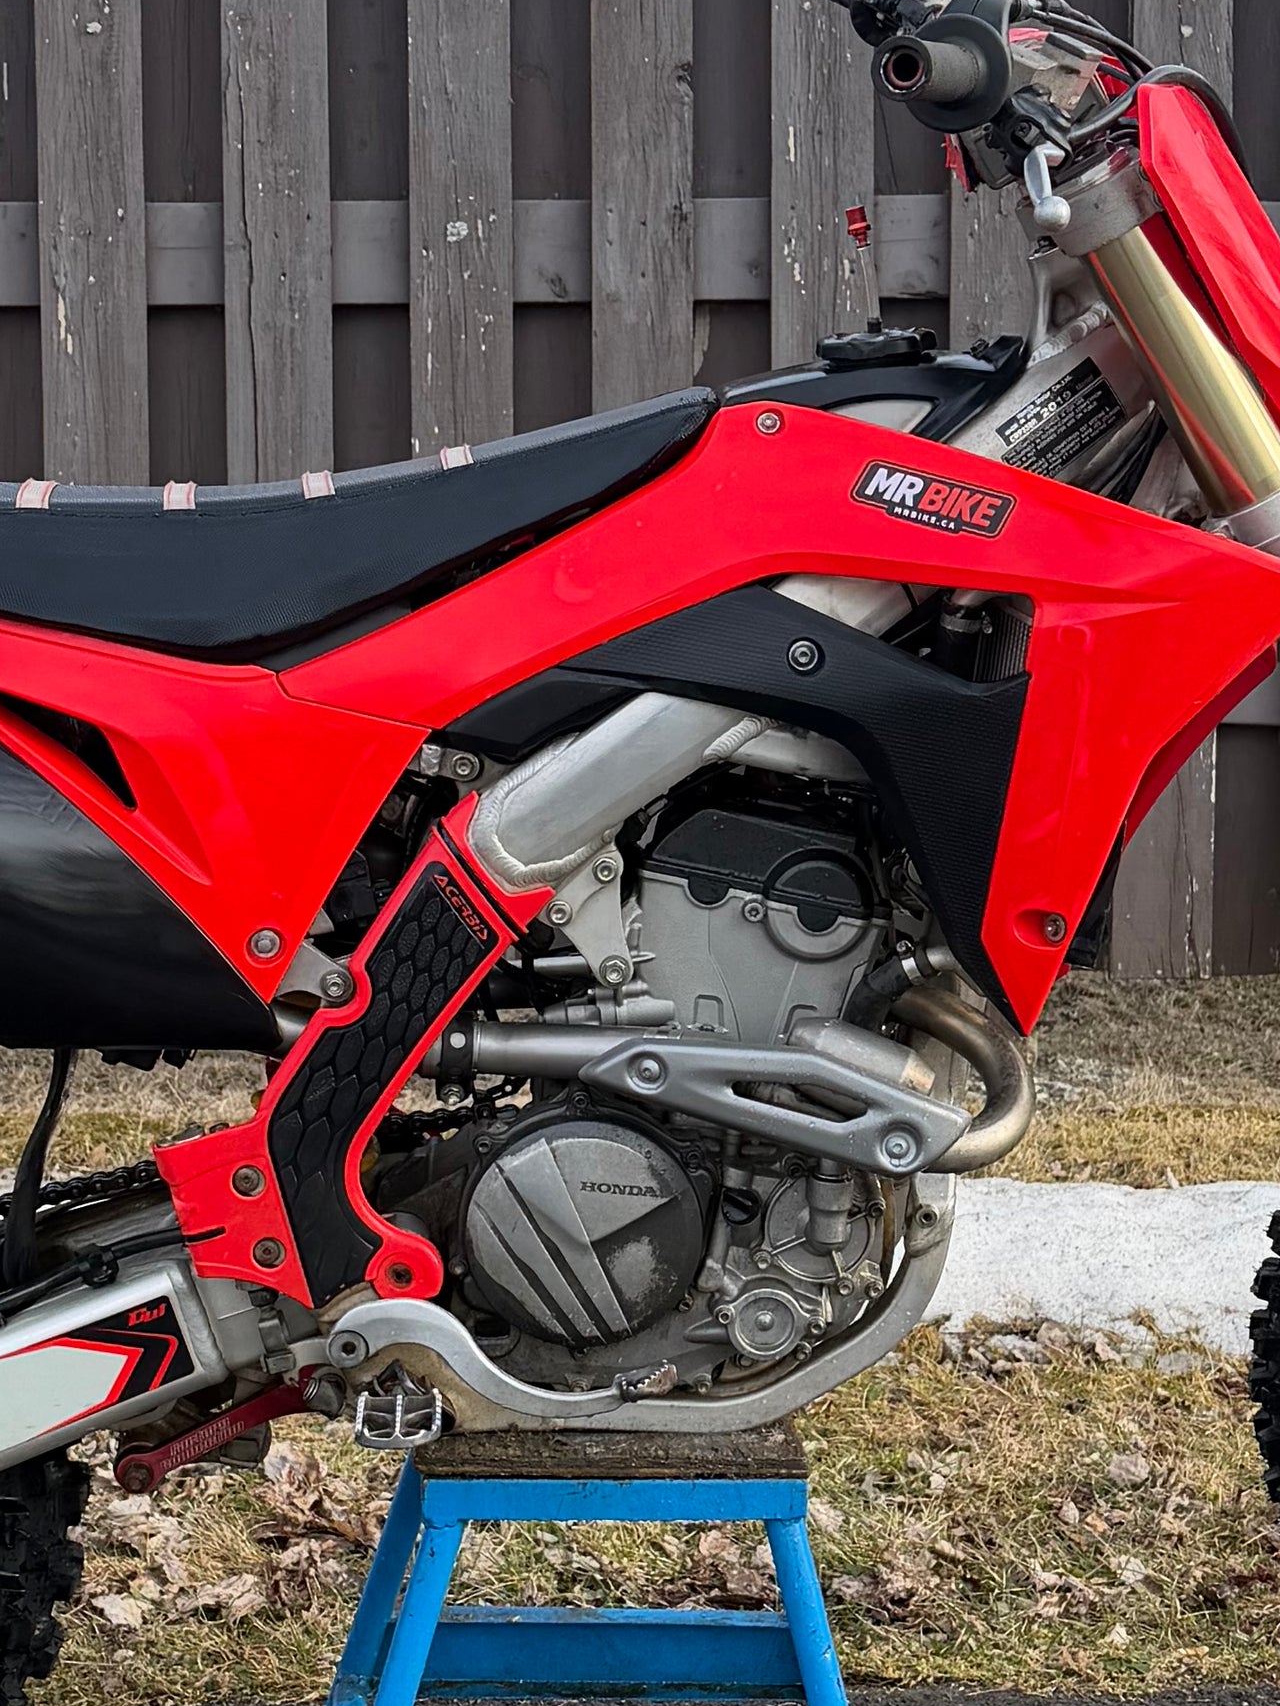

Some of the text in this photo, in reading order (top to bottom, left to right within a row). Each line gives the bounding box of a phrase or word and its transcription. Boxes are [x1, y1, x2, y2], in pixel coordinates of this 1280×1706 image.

[917, 482, 1003, 528] BIKE
[893, 506, 956, 530] MRBIKE.CA
[580, 1180, 659, 1198] HONDA
